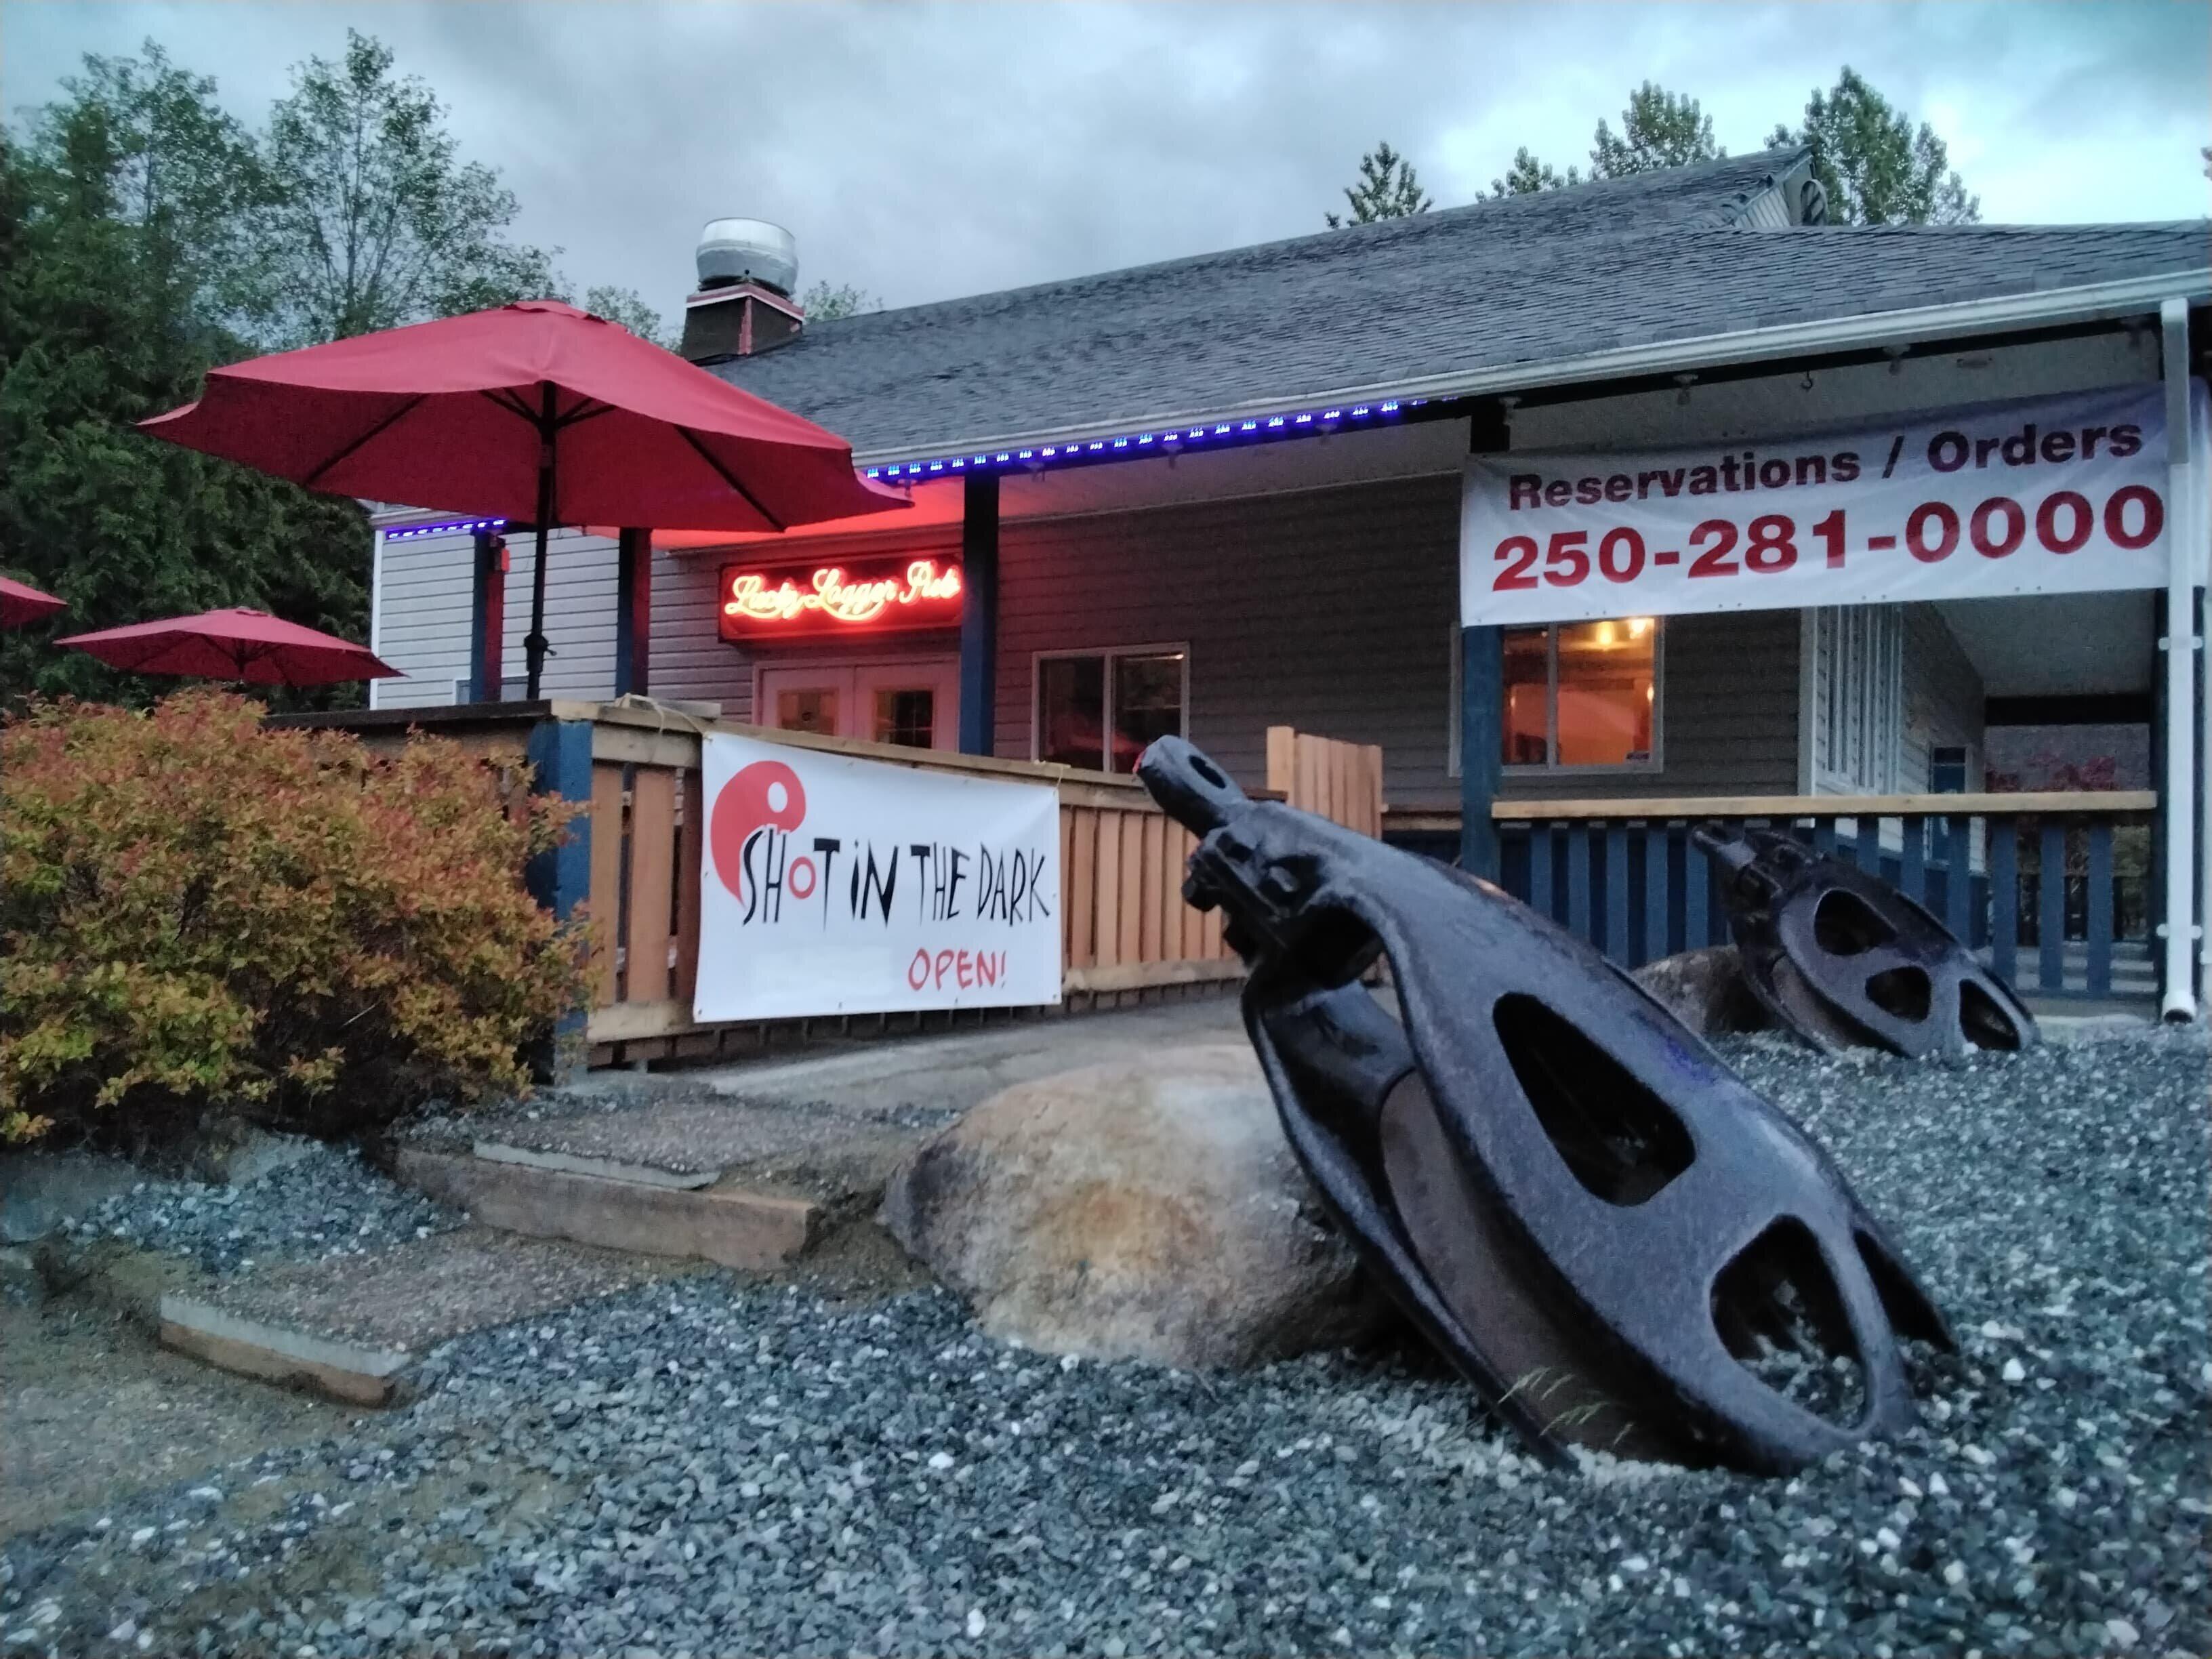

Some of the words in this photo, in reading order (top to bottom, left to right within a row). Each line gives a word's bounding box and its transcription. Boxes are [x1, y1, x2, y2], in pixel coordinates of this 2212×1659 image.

[1509, 451, 1861, 510] Reservations
[1927, 424, 2142, 472] Orders
[1492, 485, 2163, 592] 250-281-0000
[803, 568, 897, 621] Logger
[743, 828, 840, 931] SHOT
[911, 842, 970, 926] THE
[977, 842, 1050, 927] DARK
[908, 948, 1007, 991] OPEN!
